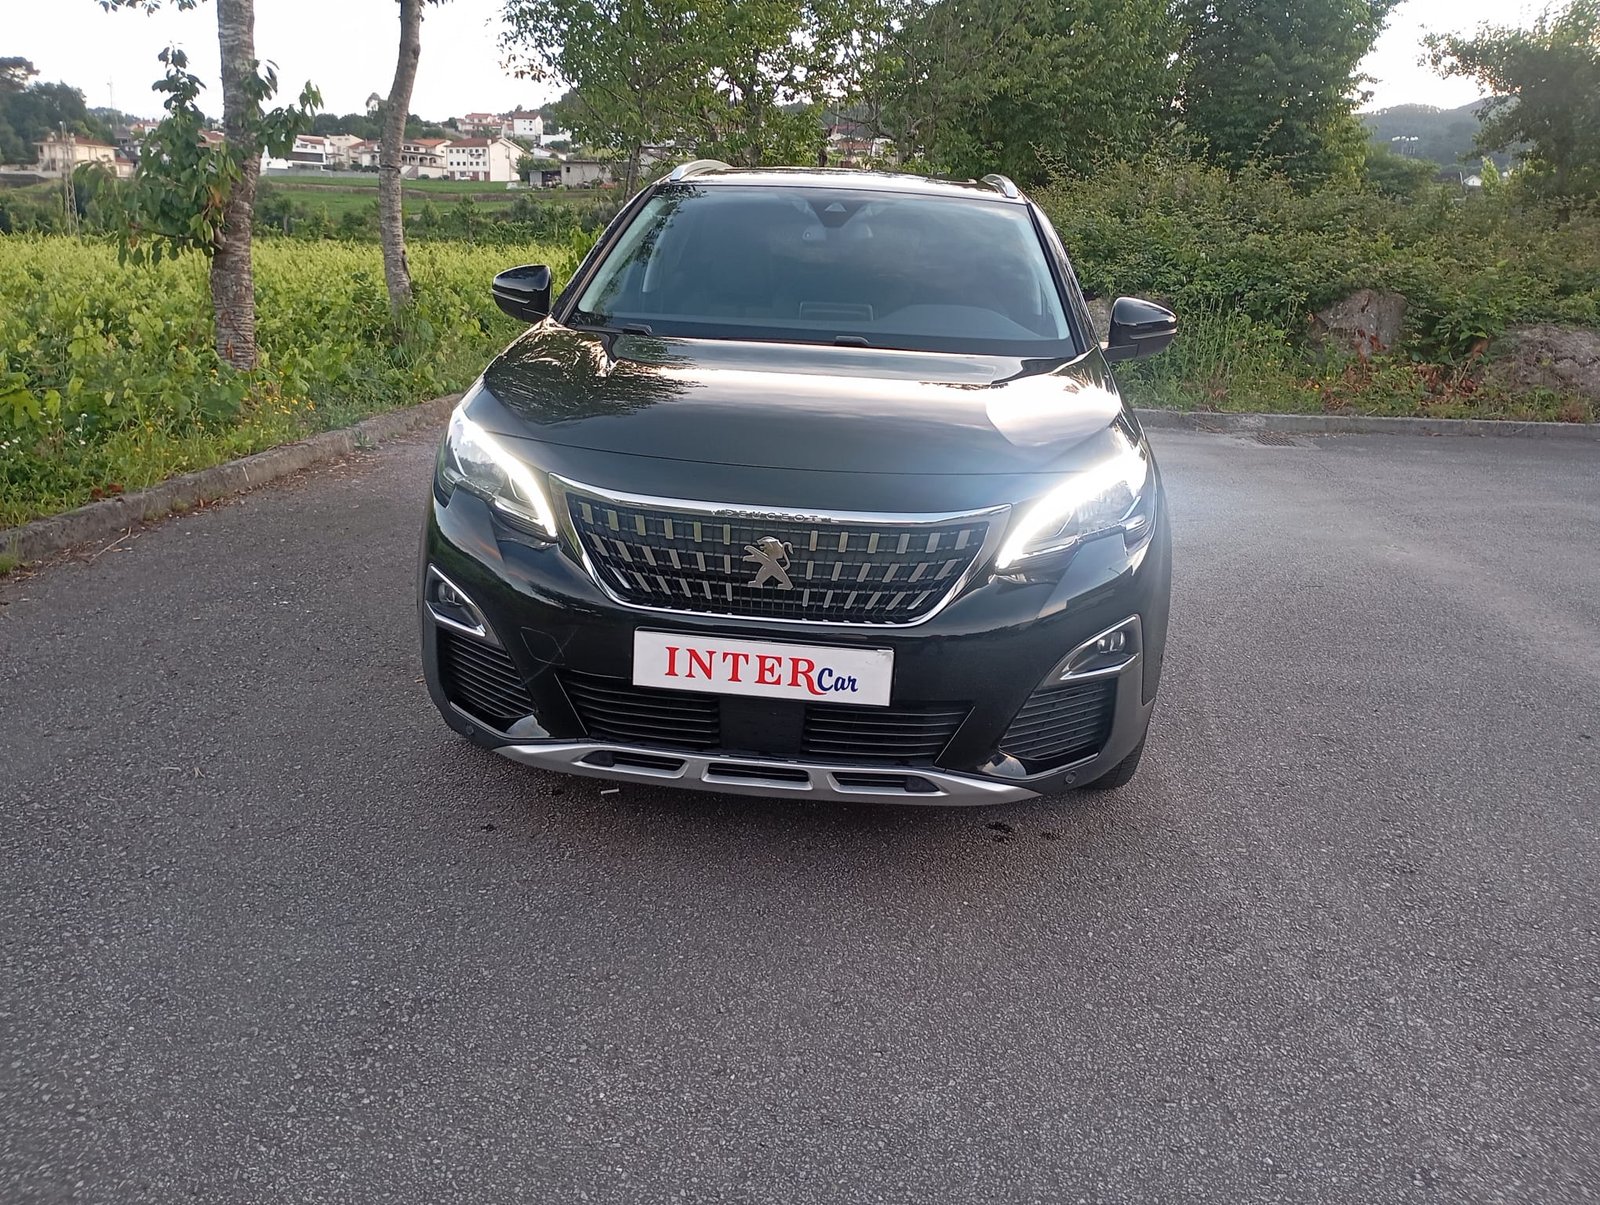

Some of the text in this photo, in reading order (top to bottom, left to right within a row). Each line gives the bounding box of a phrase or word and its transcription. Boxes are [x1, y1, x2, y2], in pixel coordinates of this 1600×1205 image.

[725, 509, 819, 523] PEUGEOT
[664, 646, 859, 695] INTER Car
